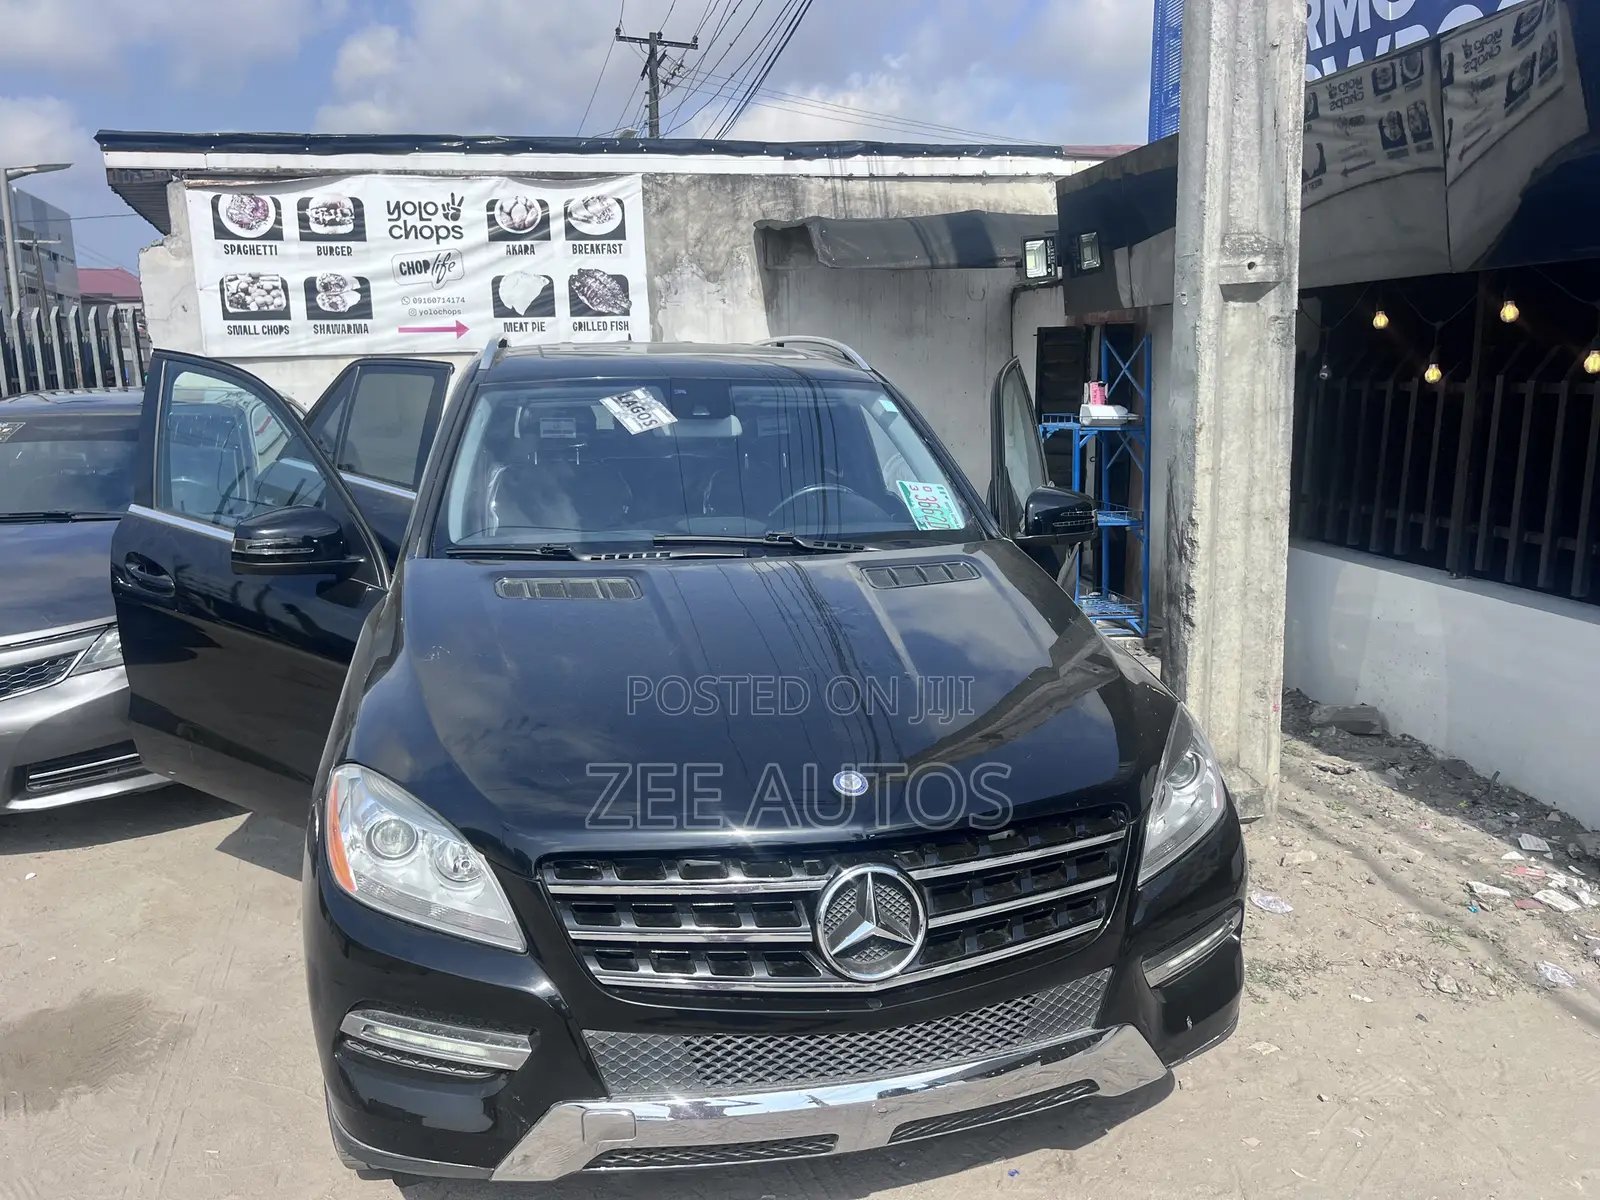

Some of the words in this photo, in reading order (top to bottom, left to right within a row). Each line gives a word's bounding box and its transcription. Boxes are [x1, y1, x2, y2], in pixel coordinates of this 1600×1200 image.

[388, 220, 464, 245] chops
[223, 244, 278, 256] SPAGHETTI
[316, 246, 353, 257] BURGER
[506, 244, 536, 255] AKARA
[572, 243, 623, 255] BREAKFAST
[399, 259, 431, 276] CHOP
[412, 296, 466, 305] 09160714174
[418, 308, 462, 316] yolochops
[227, 325, 260, 336] SMALL
[262, 324, 290, 335] CHOPS
[313, 323, 370, 335] SHAWARMA
[503, 321, 529, 333] MEAT
[531, 321, 546, 332] PIE
[572, 320, 608, 332] GRILLED
[610, 320, 630, 331] FISH
[614, 393, 659, 428] LAGOS
